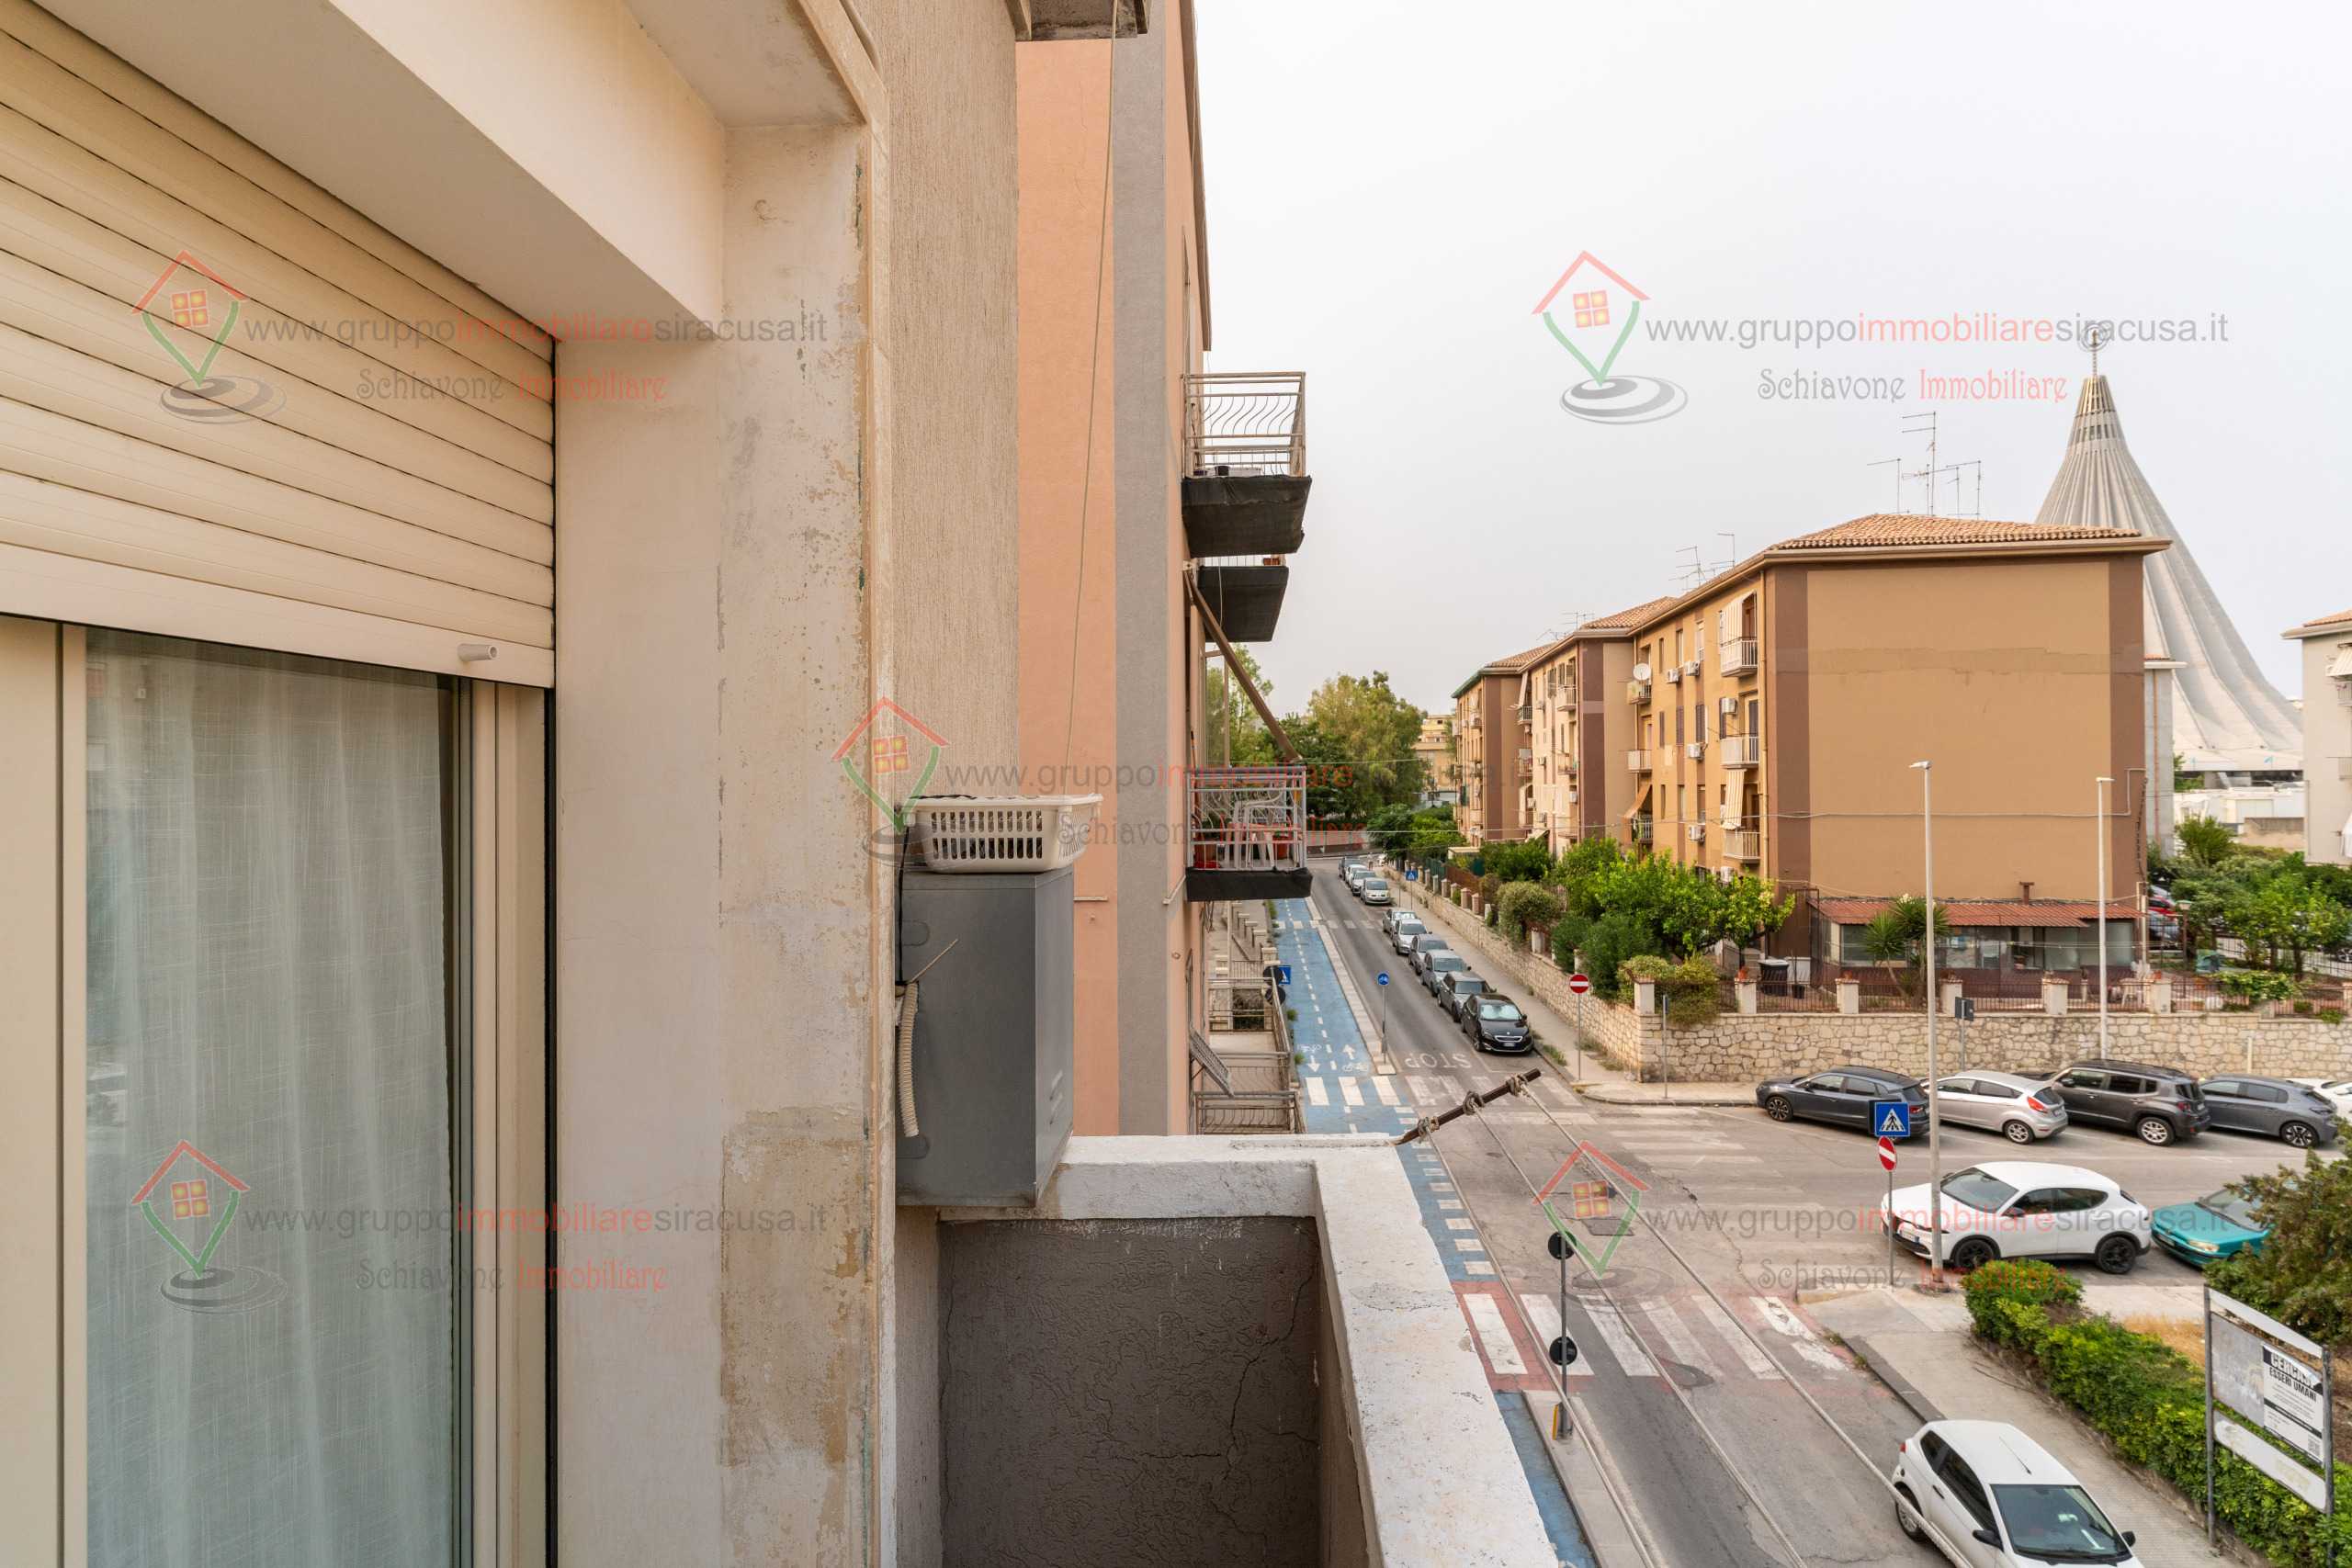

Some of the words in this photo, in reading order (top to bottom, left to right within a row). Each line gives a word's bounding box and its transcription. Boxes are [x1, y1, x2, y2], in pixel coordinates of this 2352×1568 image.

[1405, 1052, 1473, 1068] STOP
[2269, 1366, 2292, 1387] ESSERI
[2293, 1381, 2316, 1403] UMANI
